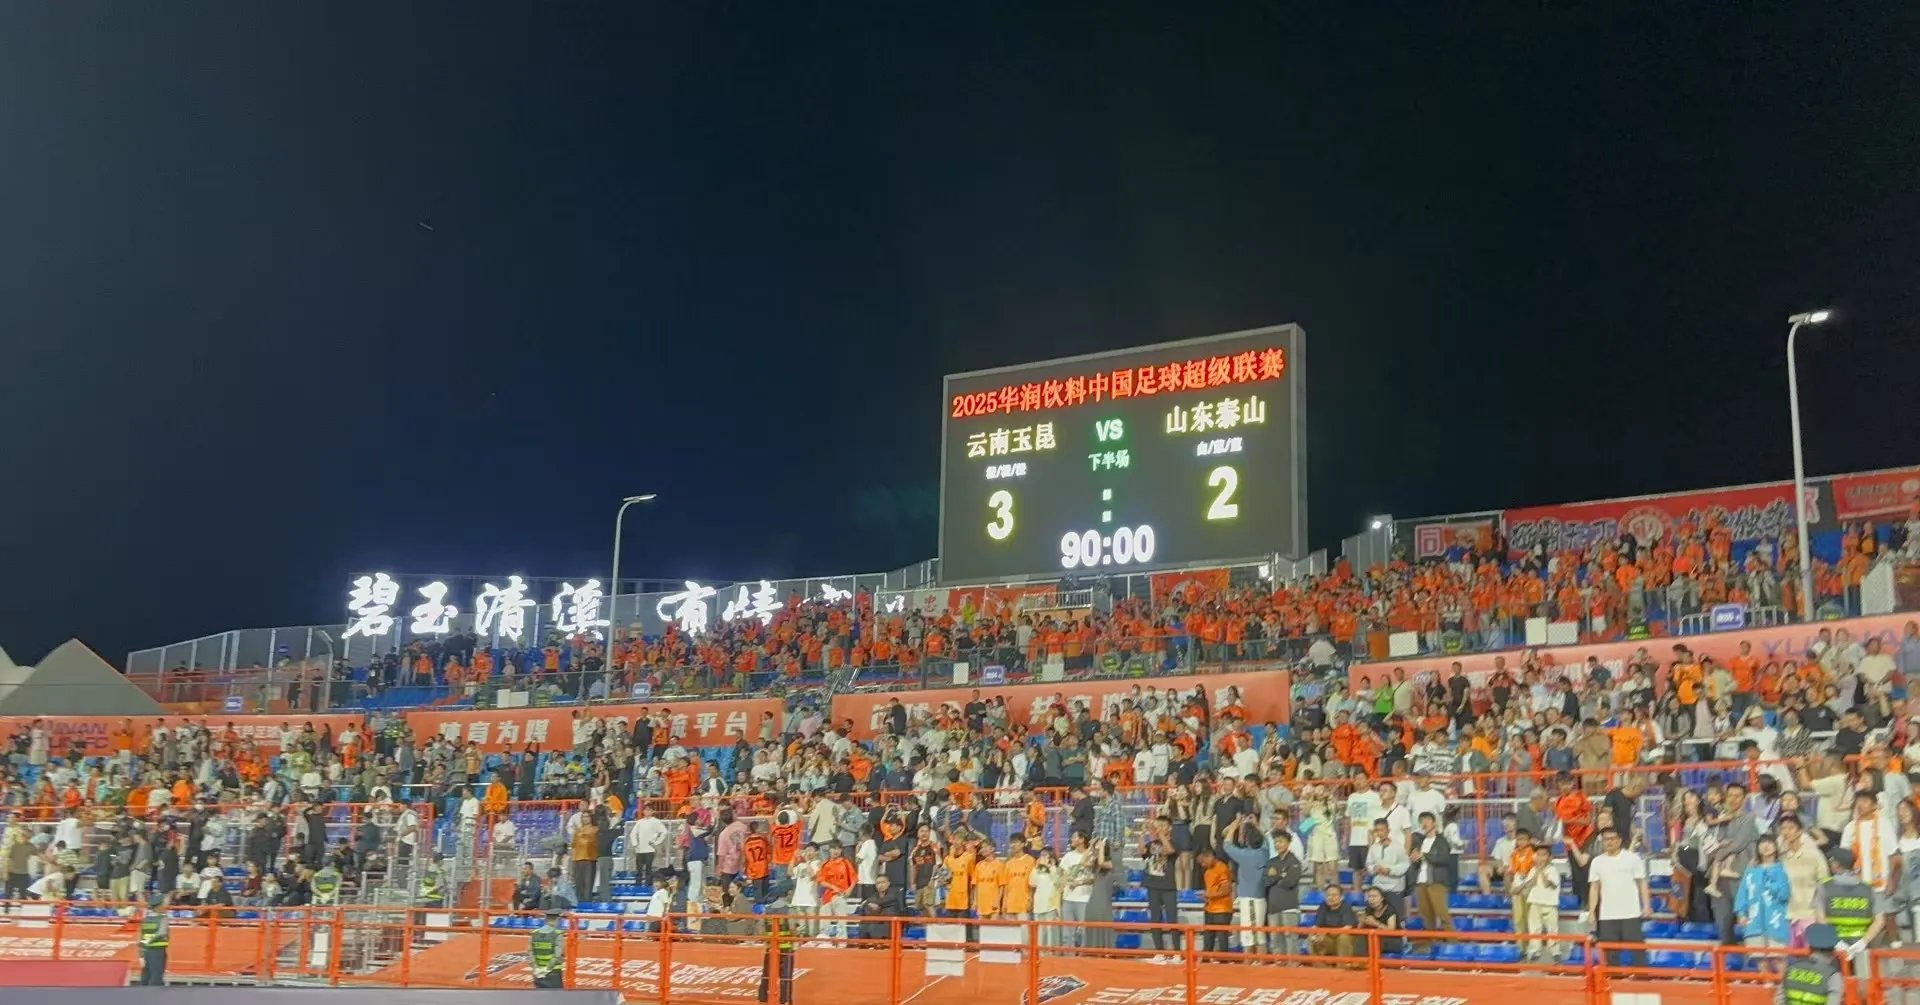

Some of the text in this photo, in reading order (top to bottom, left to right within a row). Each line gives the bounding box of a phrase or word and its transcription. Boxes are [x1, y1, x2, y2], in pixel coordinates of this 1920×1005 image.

[952, 348, 1285, 417] 2025华润饮料中国足球超级联赛
[1095, 419, 1124, 441] VS
[1166, 395, 1266, 434] 山东泰山
[966, 421, 1057, 459] 云南玉昆
[1088, 449, 1130, 472] 下半场
[987, 490, 1015, 541] 3
[1207, 466, 1239, 520] 2
[1060, 524, 1155, 569] 90:00
[341, 572, 611, 641] 碧玉清溪
[747, 846, 765, 863] 12
[777, 832, 794, 849] 12
